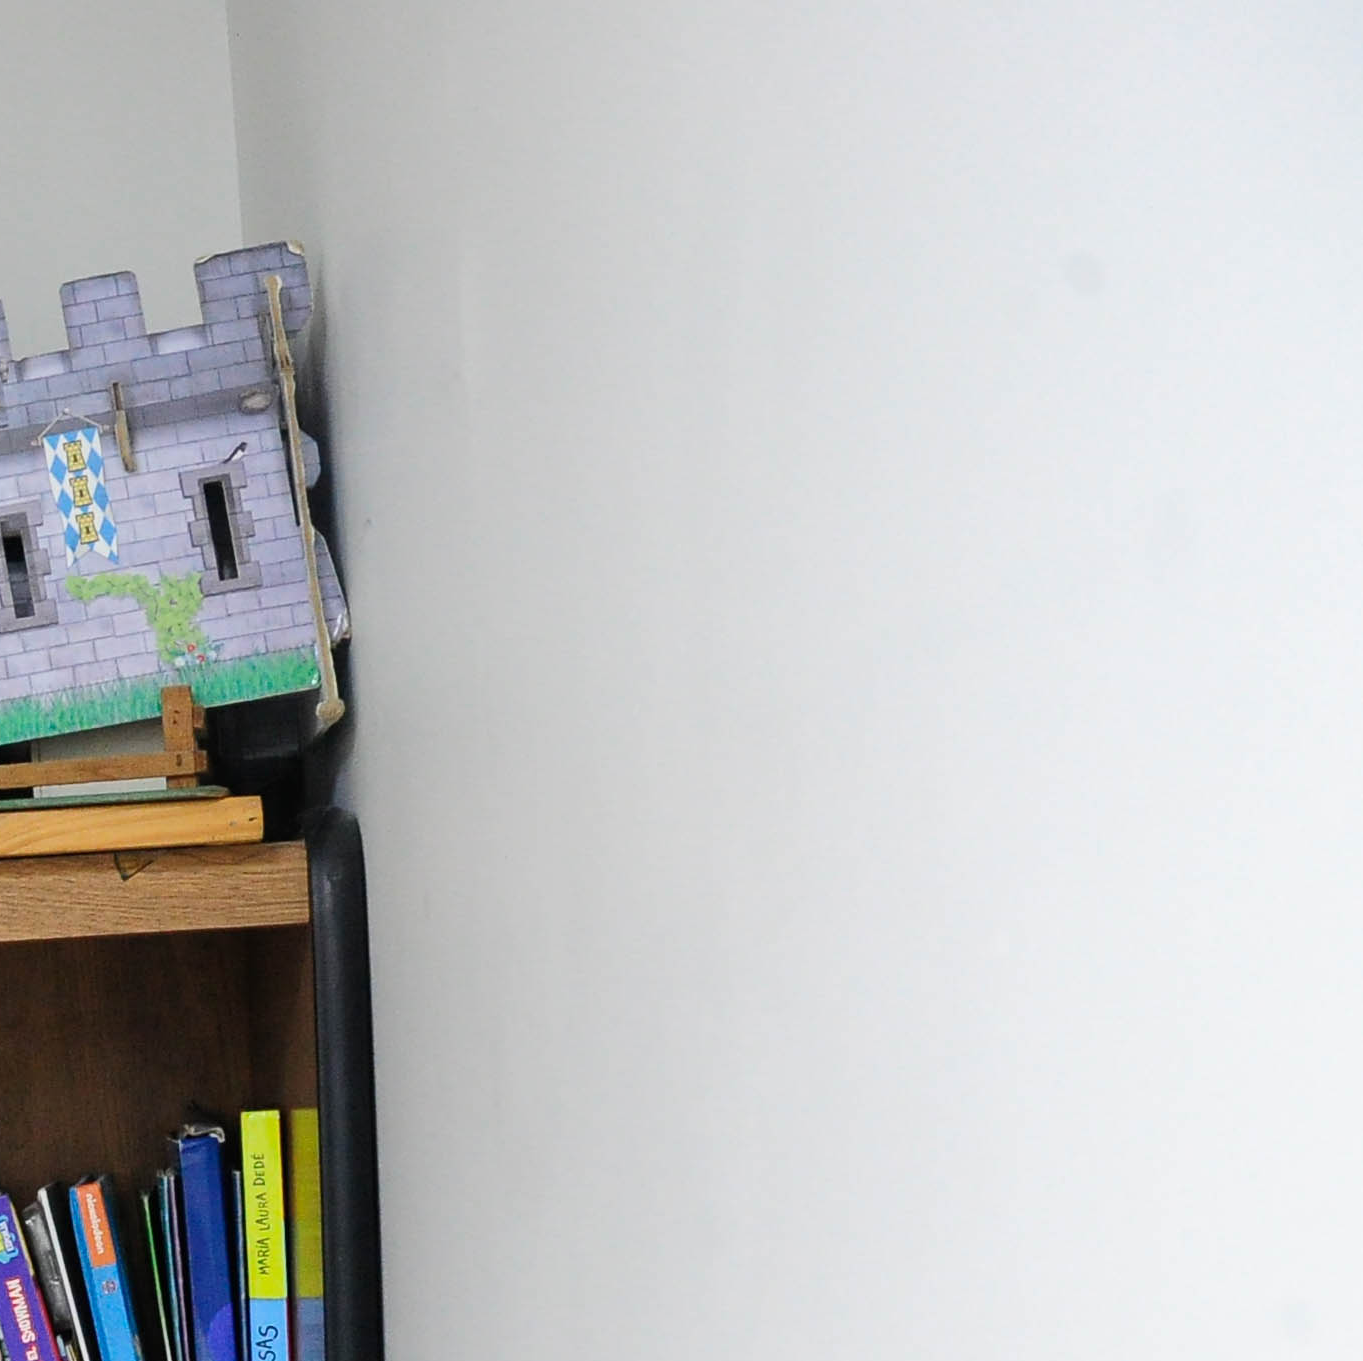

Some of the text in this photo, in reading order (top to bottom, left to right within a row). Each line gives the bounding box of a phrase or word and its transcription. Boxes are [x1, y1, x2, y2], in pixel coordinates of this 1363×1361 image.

[84, 1191, 106, 1255] nickelodeon
[251, 1152, 272, 1275] MARÍA LAURA DEDÉ
[4, 1276, 37, 1344] SHOWMAN
